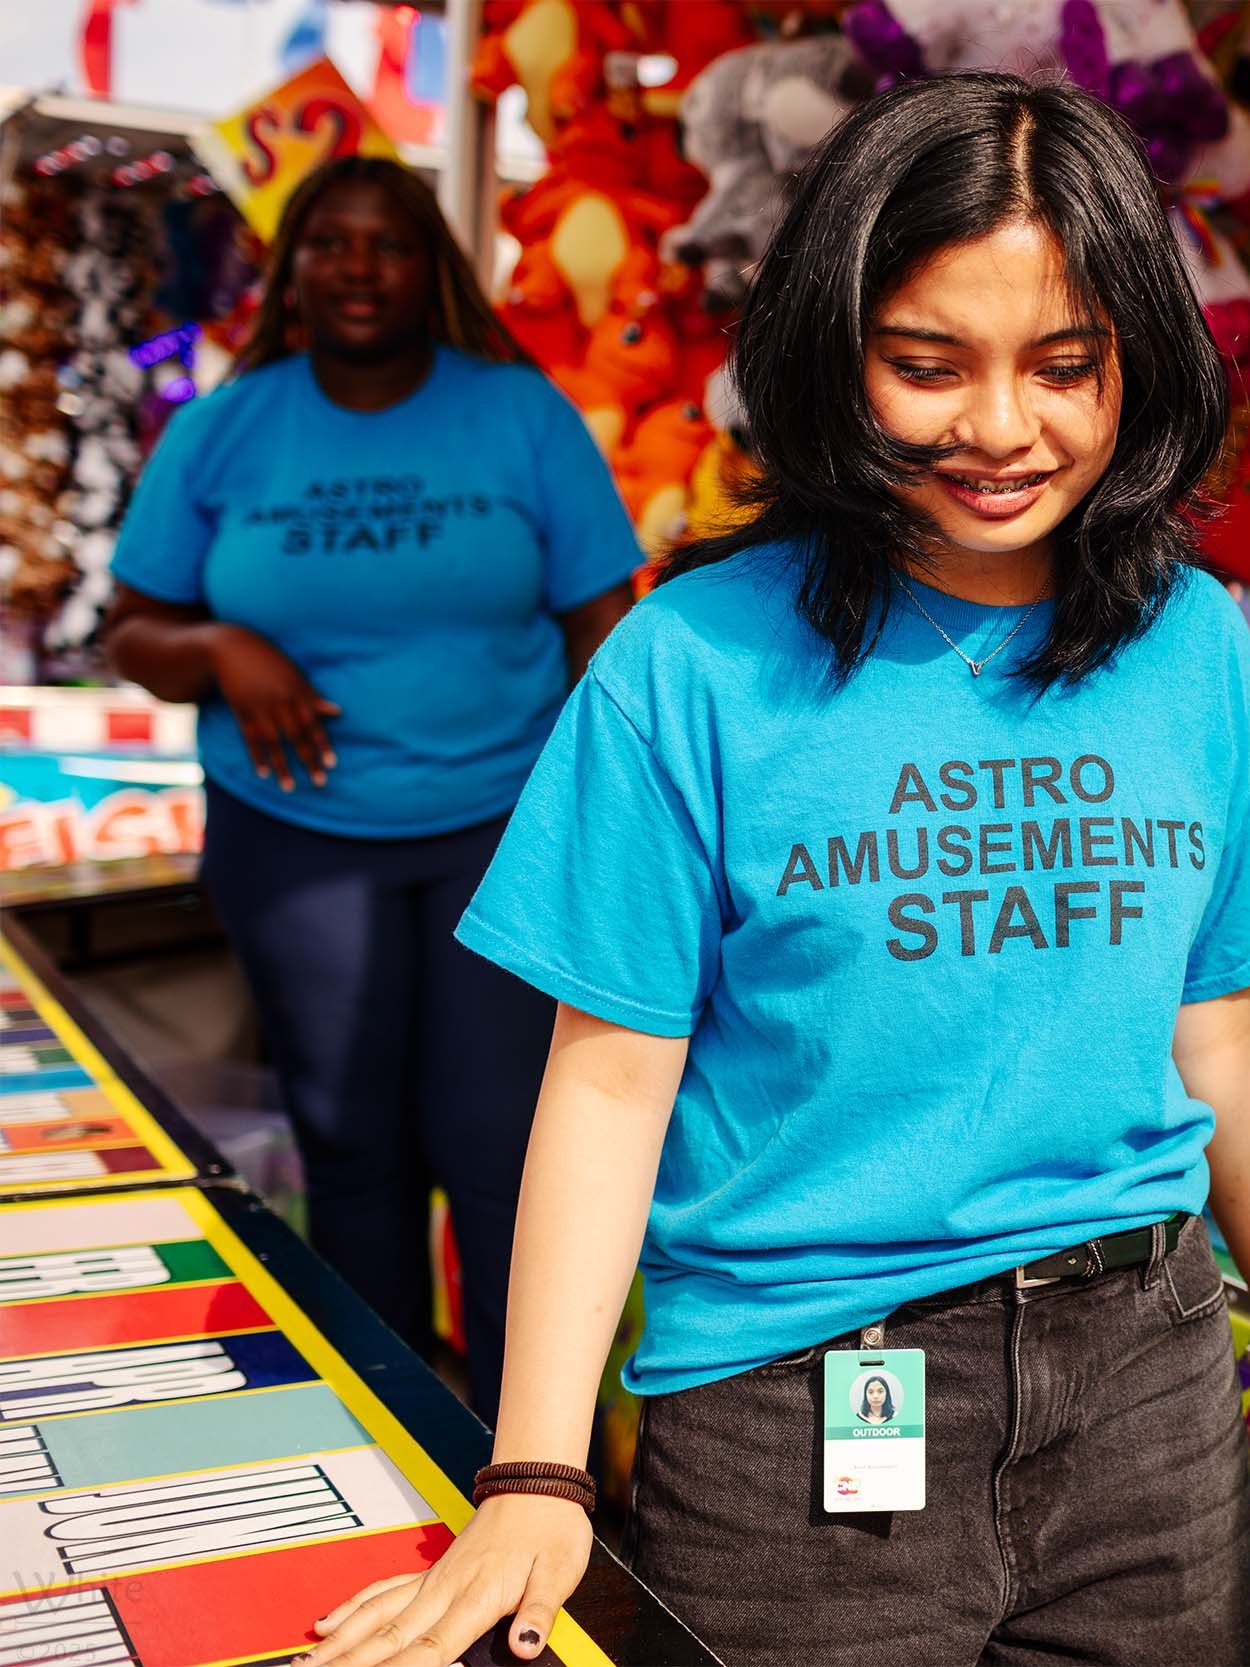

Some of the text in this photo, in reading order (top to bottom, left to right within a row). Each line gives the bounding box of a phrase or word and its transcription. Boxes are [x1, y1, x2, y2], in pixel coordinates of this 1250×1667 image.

[282, 522, 443, 555] STAFF
[888, 754, 1115, 814] ASTRO
[776, 817, 1206, 897] AMUSEMENTS
[885, 880, 1146, 962] STAFF
[0, 1341, 247, 1420] APR
[852, 1427, 901, 1437] OUTDOOR
[38, 1464, 364, 1575] JUN
